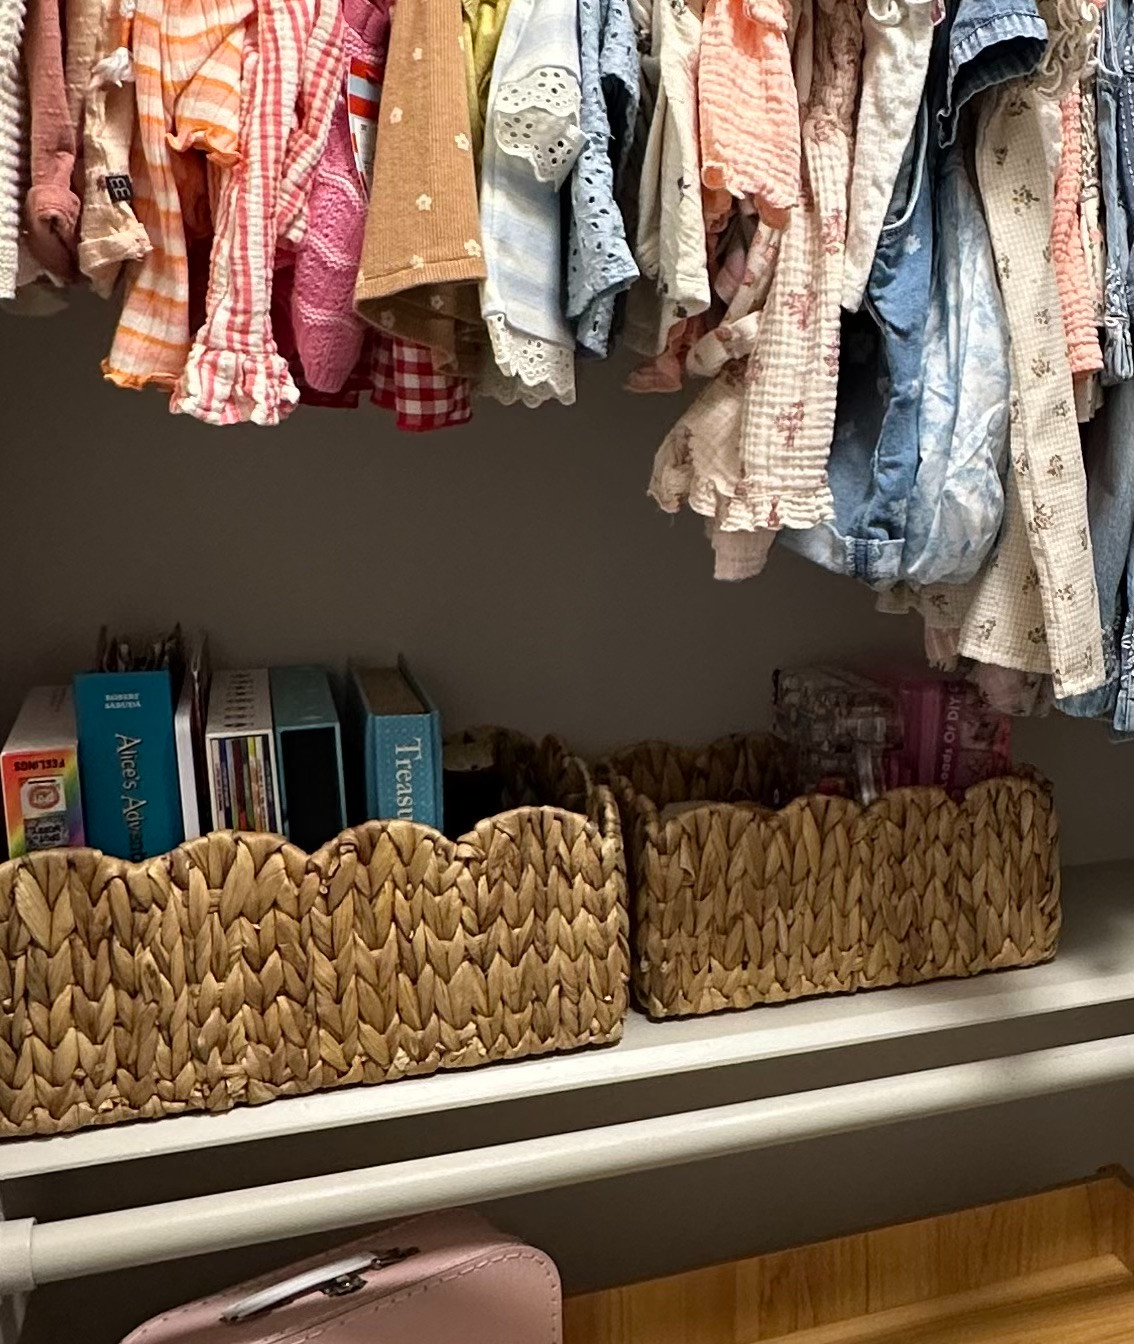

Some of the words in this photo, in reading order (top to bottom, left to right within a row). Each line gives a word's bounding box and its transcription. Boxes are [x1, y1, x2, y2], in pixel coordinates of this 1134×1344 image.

[947, 697, 961, 721] DIY
[13, 758, 66, 772] FEELINGS
[115, 733, 143, 790] Alice's
[394, 736, 423, 821] Treasu
